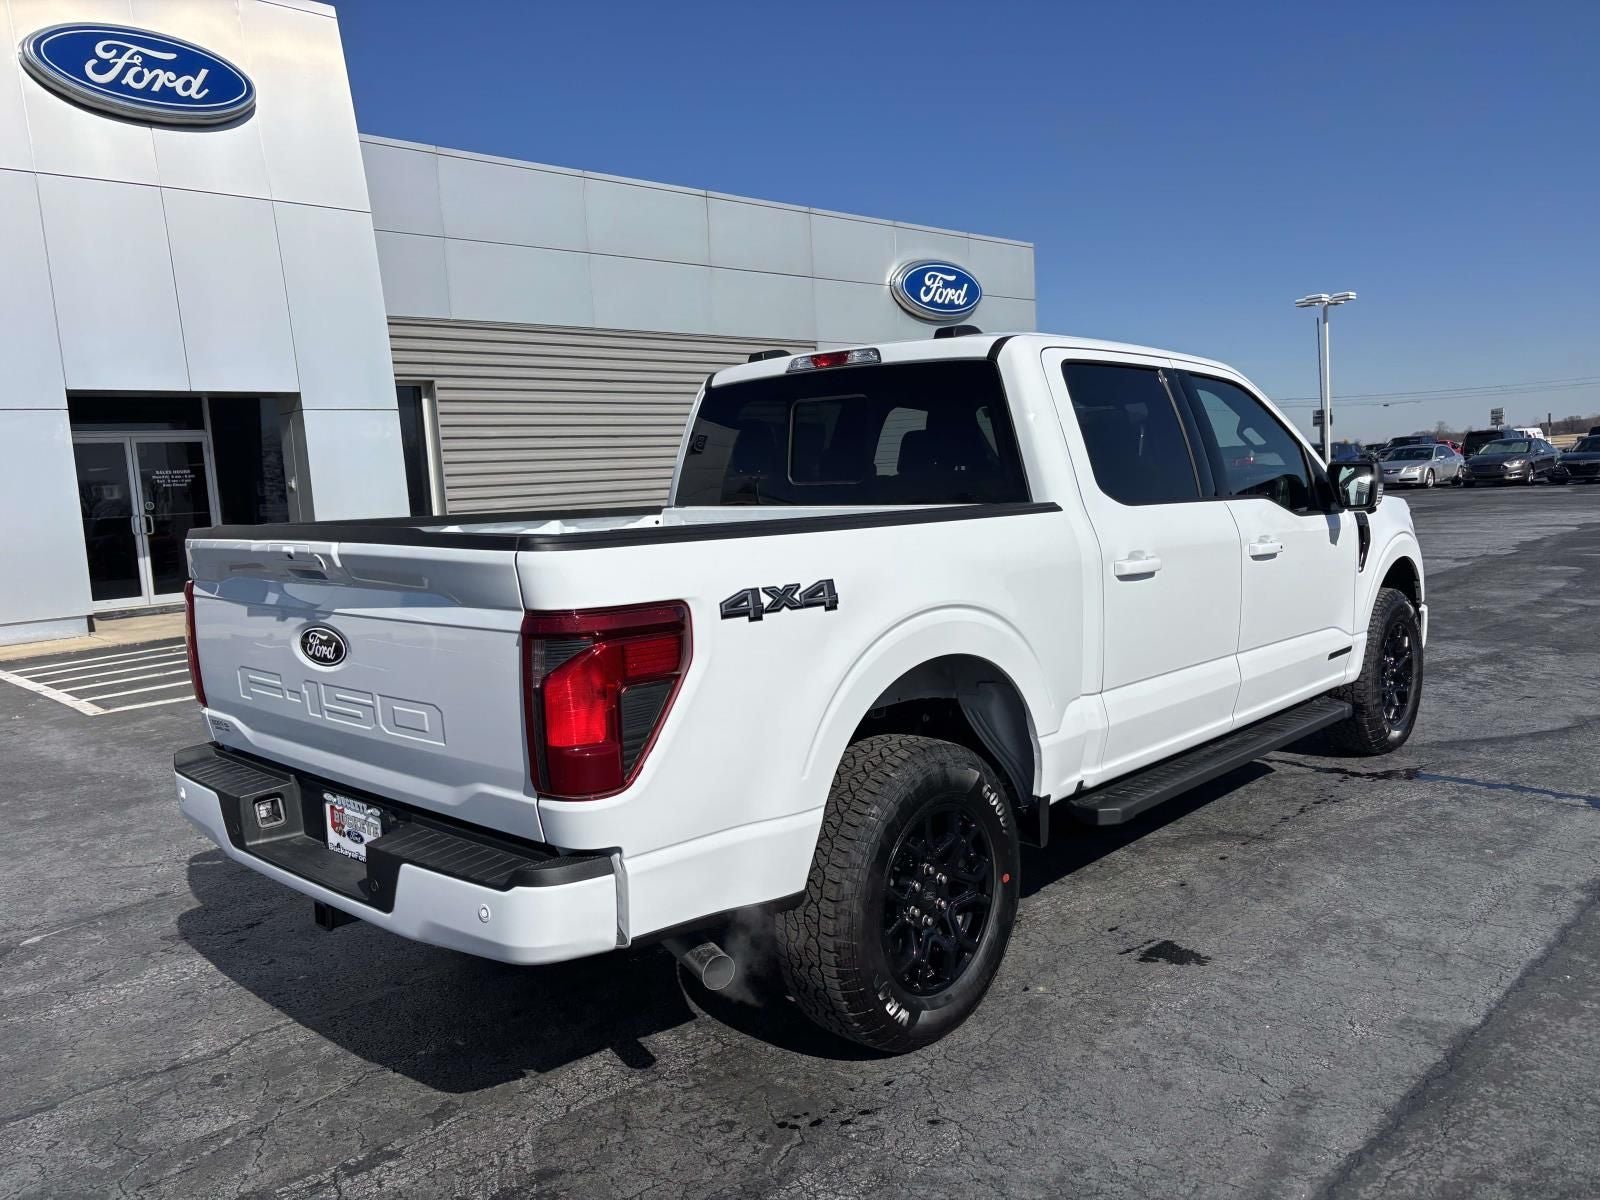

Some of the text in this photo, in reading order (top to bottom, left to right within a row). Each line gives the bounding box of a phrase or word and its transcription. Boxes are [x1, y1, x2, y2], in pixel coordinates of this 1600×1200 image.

[85, 40, 209, 100] Ford
[920, 272, 968, 305] Ford
[307, 632, 336, 660] Ford
[237, 665, 446, 747] F-150
[334, 812, 379, 837] BUCKEYE
